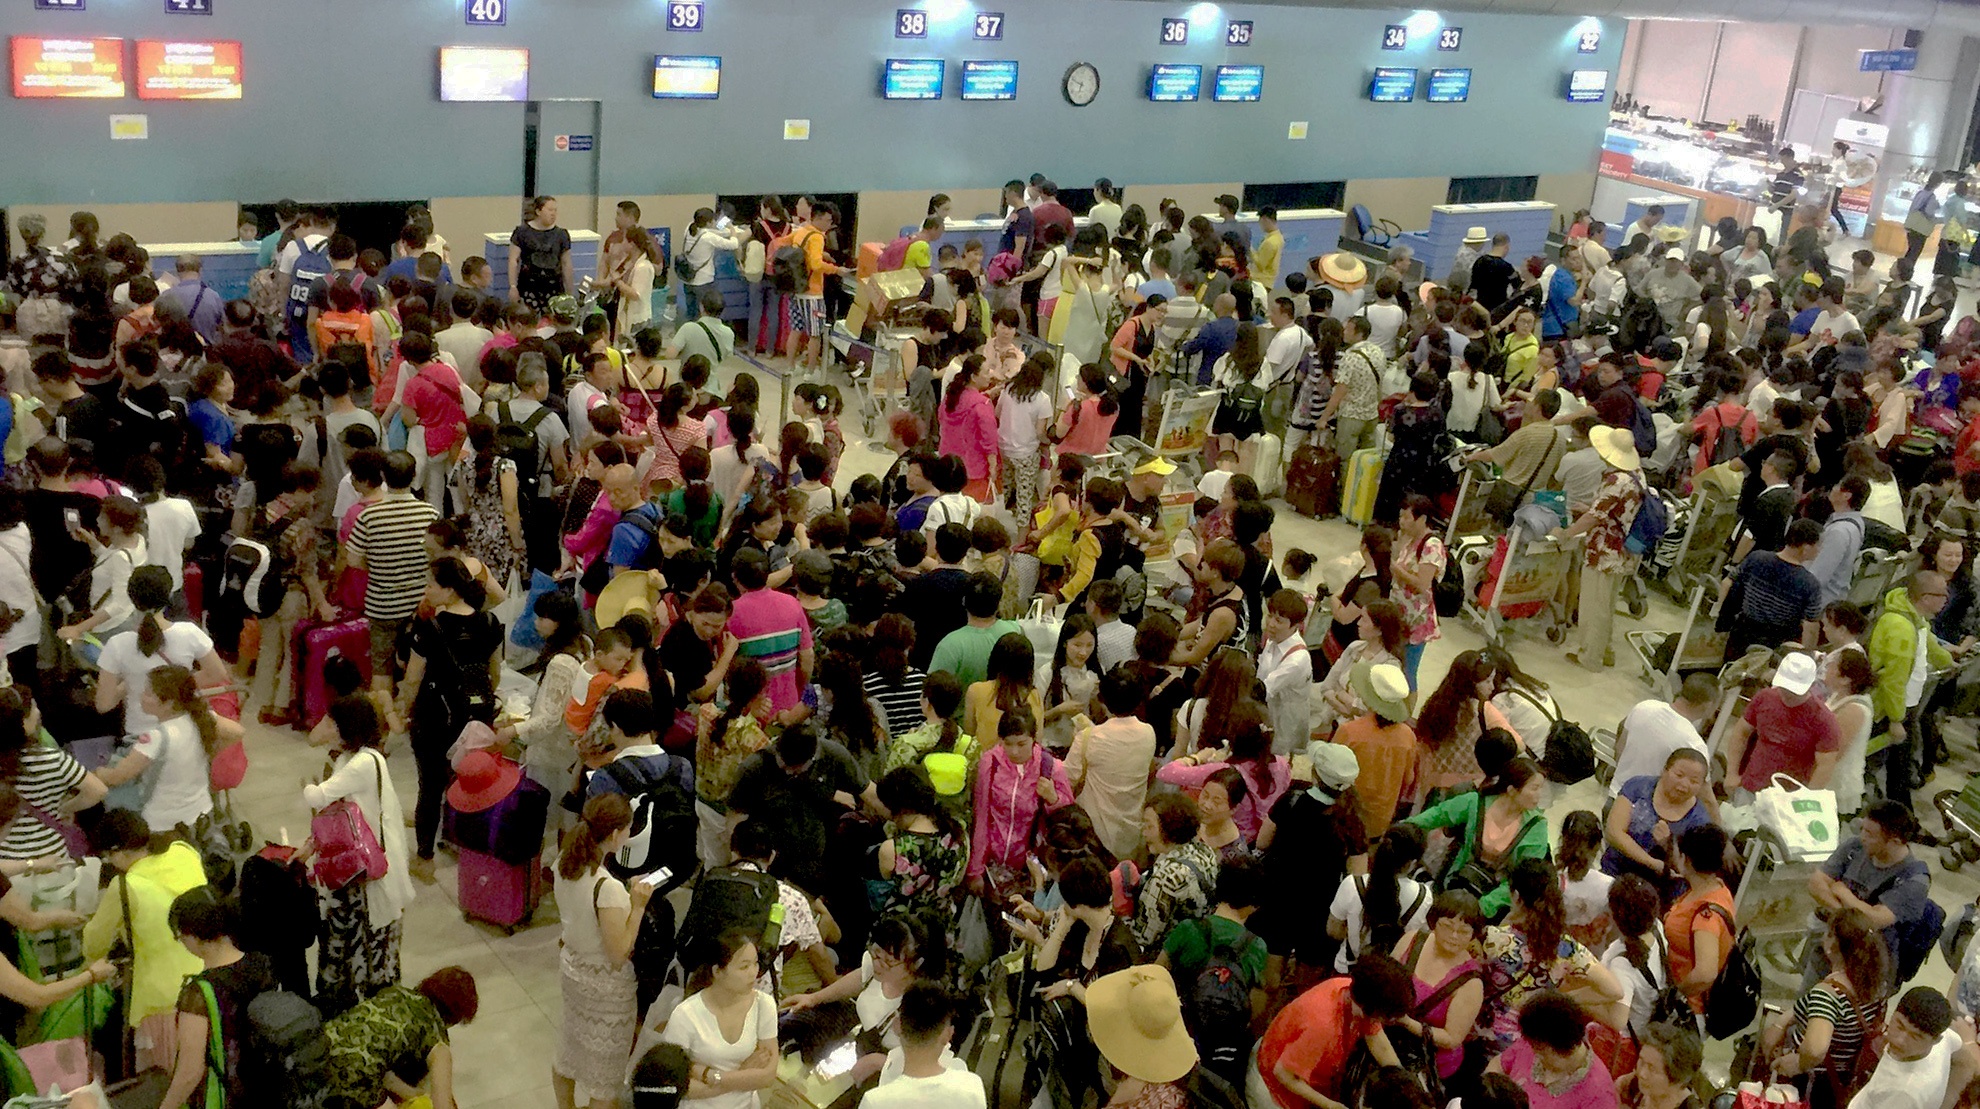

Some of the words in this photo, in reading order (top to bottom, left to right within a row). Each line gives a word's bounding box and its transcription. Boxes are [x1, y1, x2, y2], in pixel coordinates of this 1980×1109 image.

[471, 0, 501, 21] 40
[672, 5, 699, 27] 39
[901, 14, 924, 34] 38
[976, 16, 1001, 37] 37
[1164, 22, 1185, 41] 36
[1229, 24, 1249, 43] 35
[1386, 29, 1405, 46] 34
[1441, 30, 1459, 48] 33
[1580, 32, 1599, 50] 32
[290, 284, 309, 302] 03
